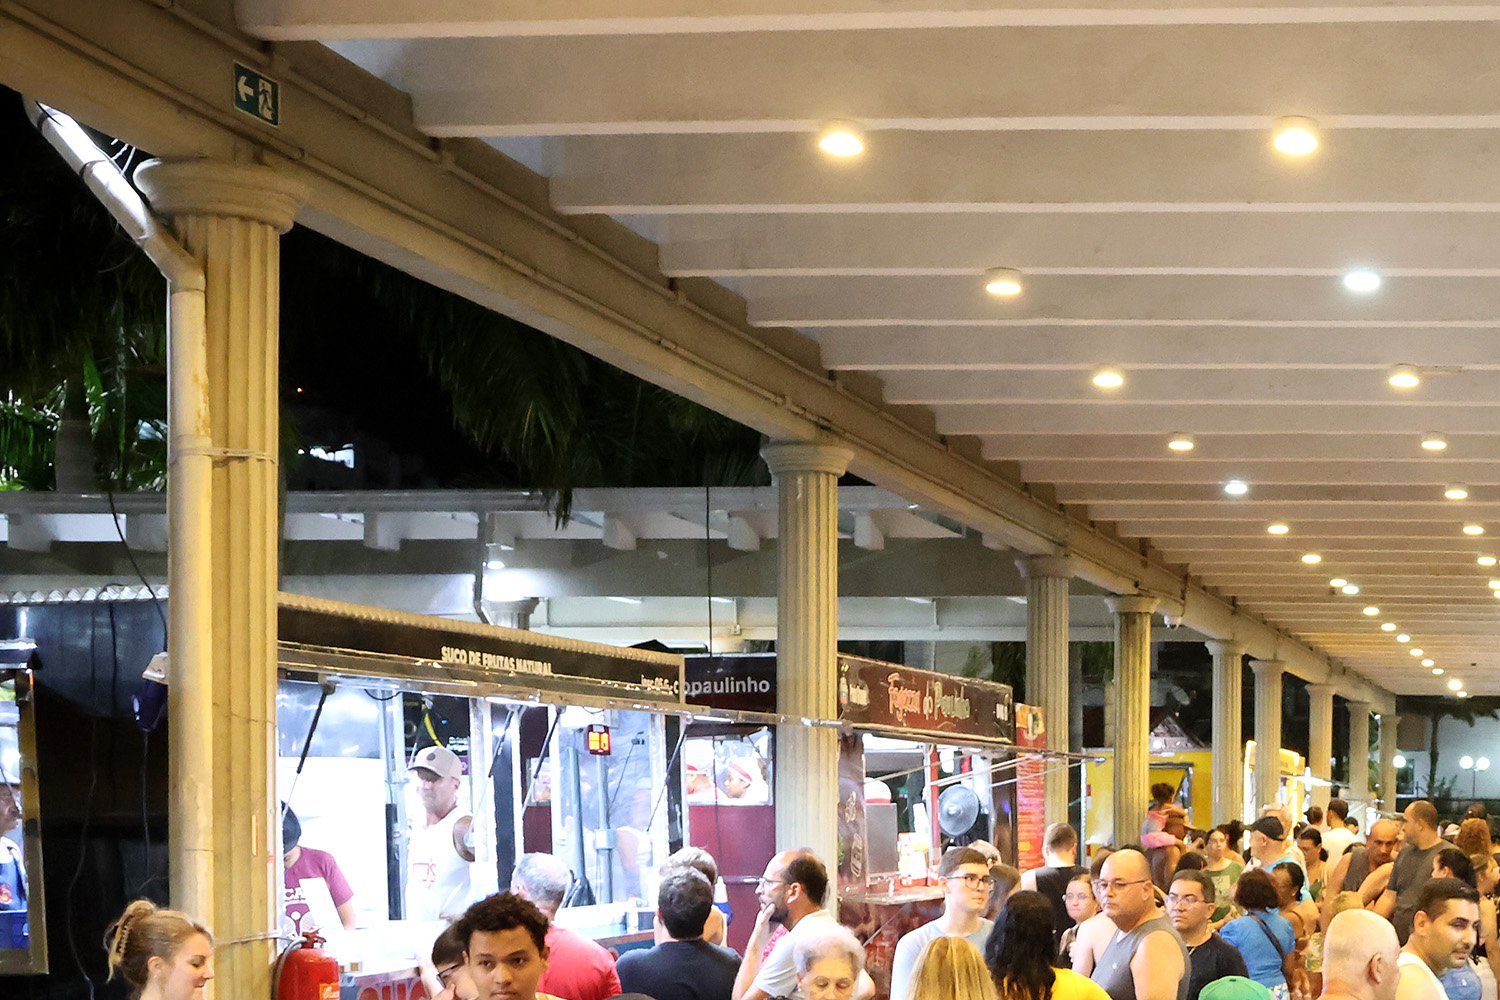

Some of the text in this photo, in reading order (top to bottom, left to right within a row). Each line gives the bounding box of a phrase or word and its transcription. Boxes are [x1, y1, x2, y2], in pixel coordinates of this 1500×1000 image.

[441, 645, 553, 675] SUCO DE FRUTAS NATURAL
